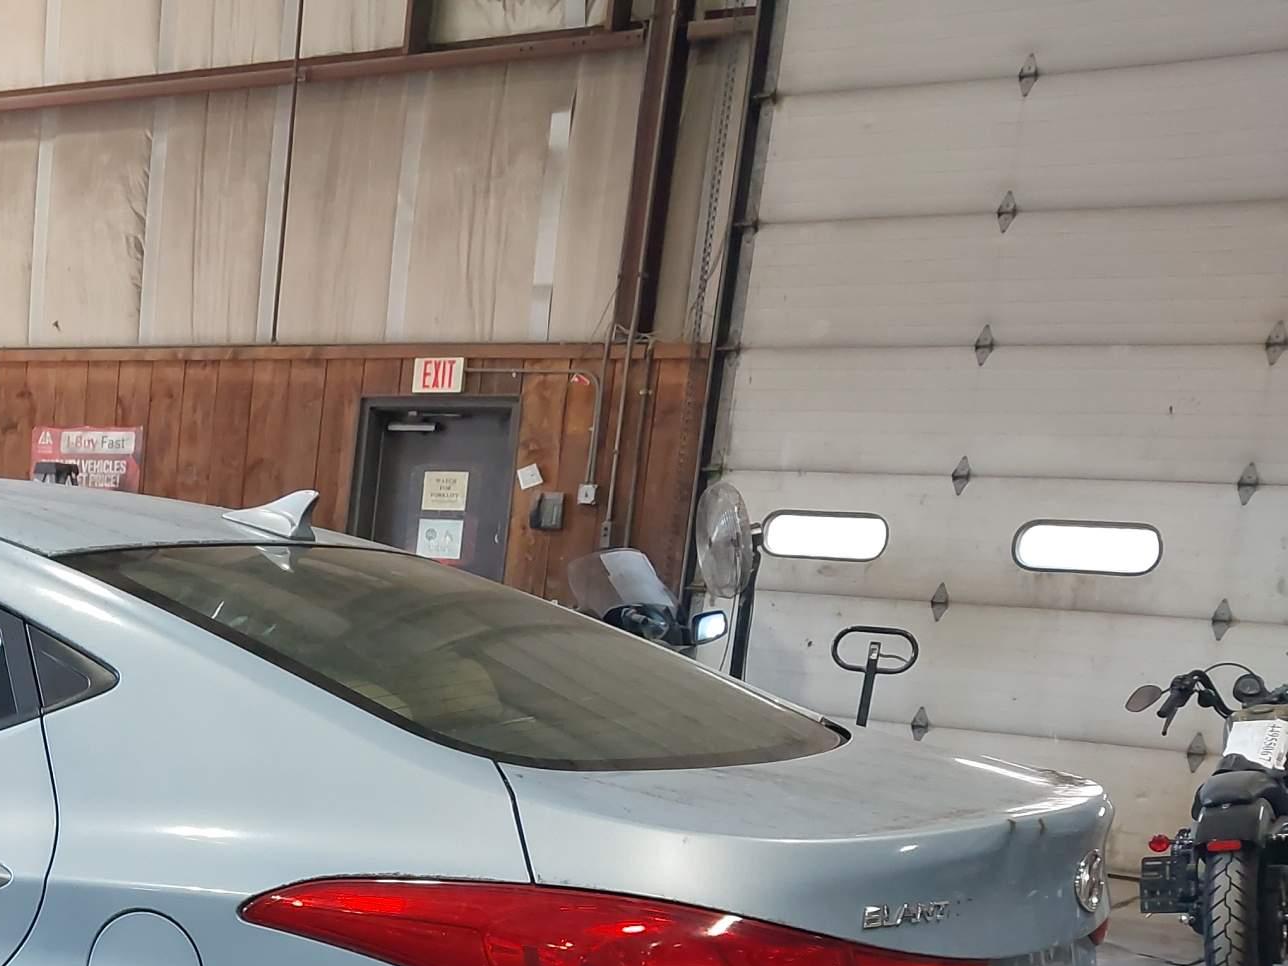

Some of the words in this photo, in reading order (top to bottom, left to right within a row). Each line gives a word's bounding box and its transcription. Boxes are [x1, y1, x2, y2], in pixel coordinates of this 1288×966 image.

[422, 360, 456, 388] EXIT
[101, 435, 125, 449] Fast
[80, 459, 127, 474] VEHICLES
[88, 473, 121, 489] PRICE!
